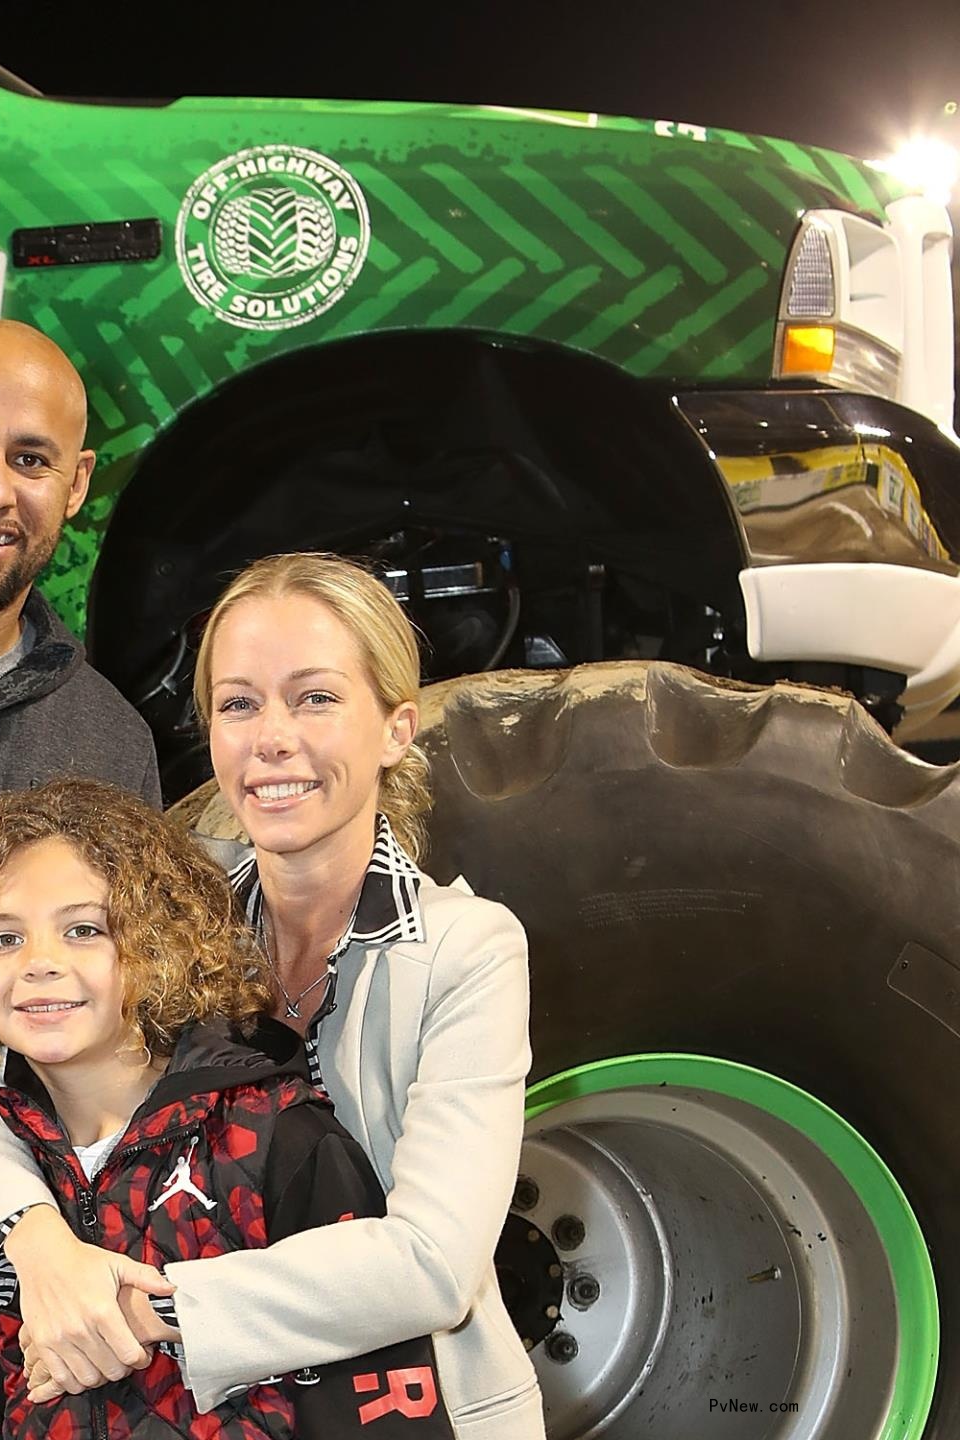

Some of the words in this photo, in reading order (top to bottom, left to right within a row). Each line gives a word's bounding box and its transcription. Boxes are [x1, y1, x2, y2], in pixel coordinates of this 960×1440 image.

[192, 155, 355, 220] OFF-HIGHWAY
[189, 242, 228, 301] TIRE
[229, 236, 358, 317] SOLUTIONS
